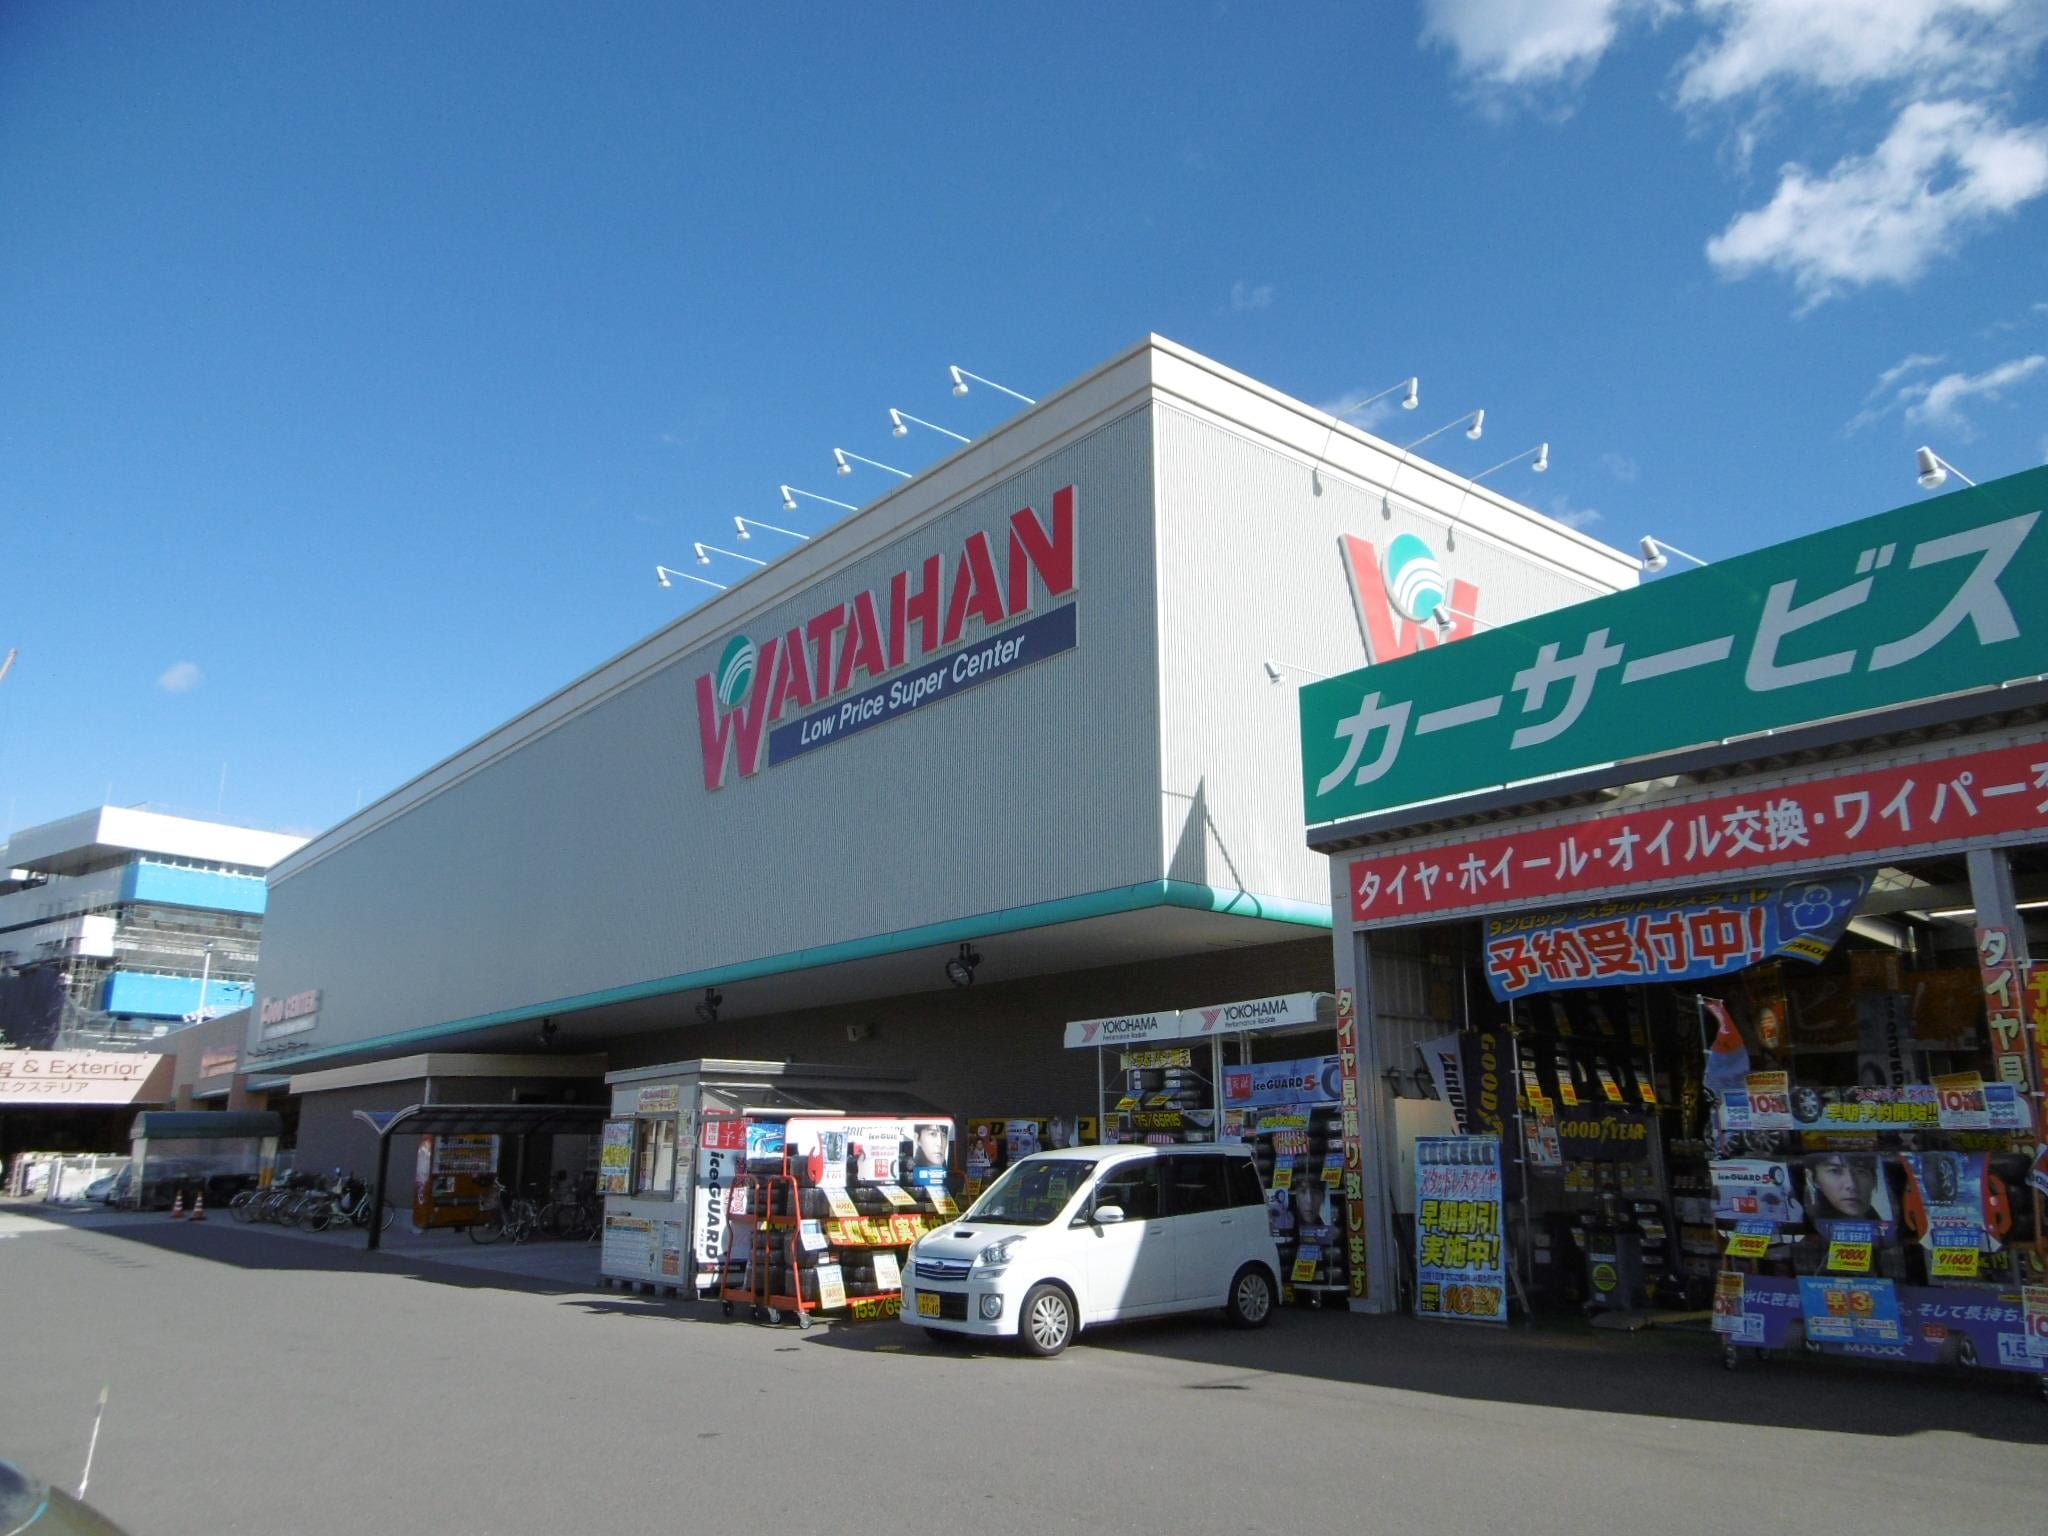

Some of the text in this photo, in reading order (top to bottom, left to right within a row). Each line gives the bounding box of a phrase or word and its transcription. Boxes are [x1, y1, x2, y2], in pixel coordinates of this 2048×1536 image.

[695, 484, 1078, 791] WATAHAN
[1317, 510, 2042, 797] カーサービス
[801, 634, 1026, 745] Low Price Super Center
[1488, 905, 1768, 992] 予約受付中!
[1101, 1016, 1158, 1033] YOKOHAMA
[1223, 999, 1288, 1020] YOKOHAMA
[23, 1059, 39, 1073] &
[50, 1060, 142, 1076] Exterior
[1559, 1116, 1649, 1143] GOODYEAR
[1419, 1199, 1498, 1234] 早期割引
[1420, 1234, 1501, 1271] 実施中!
